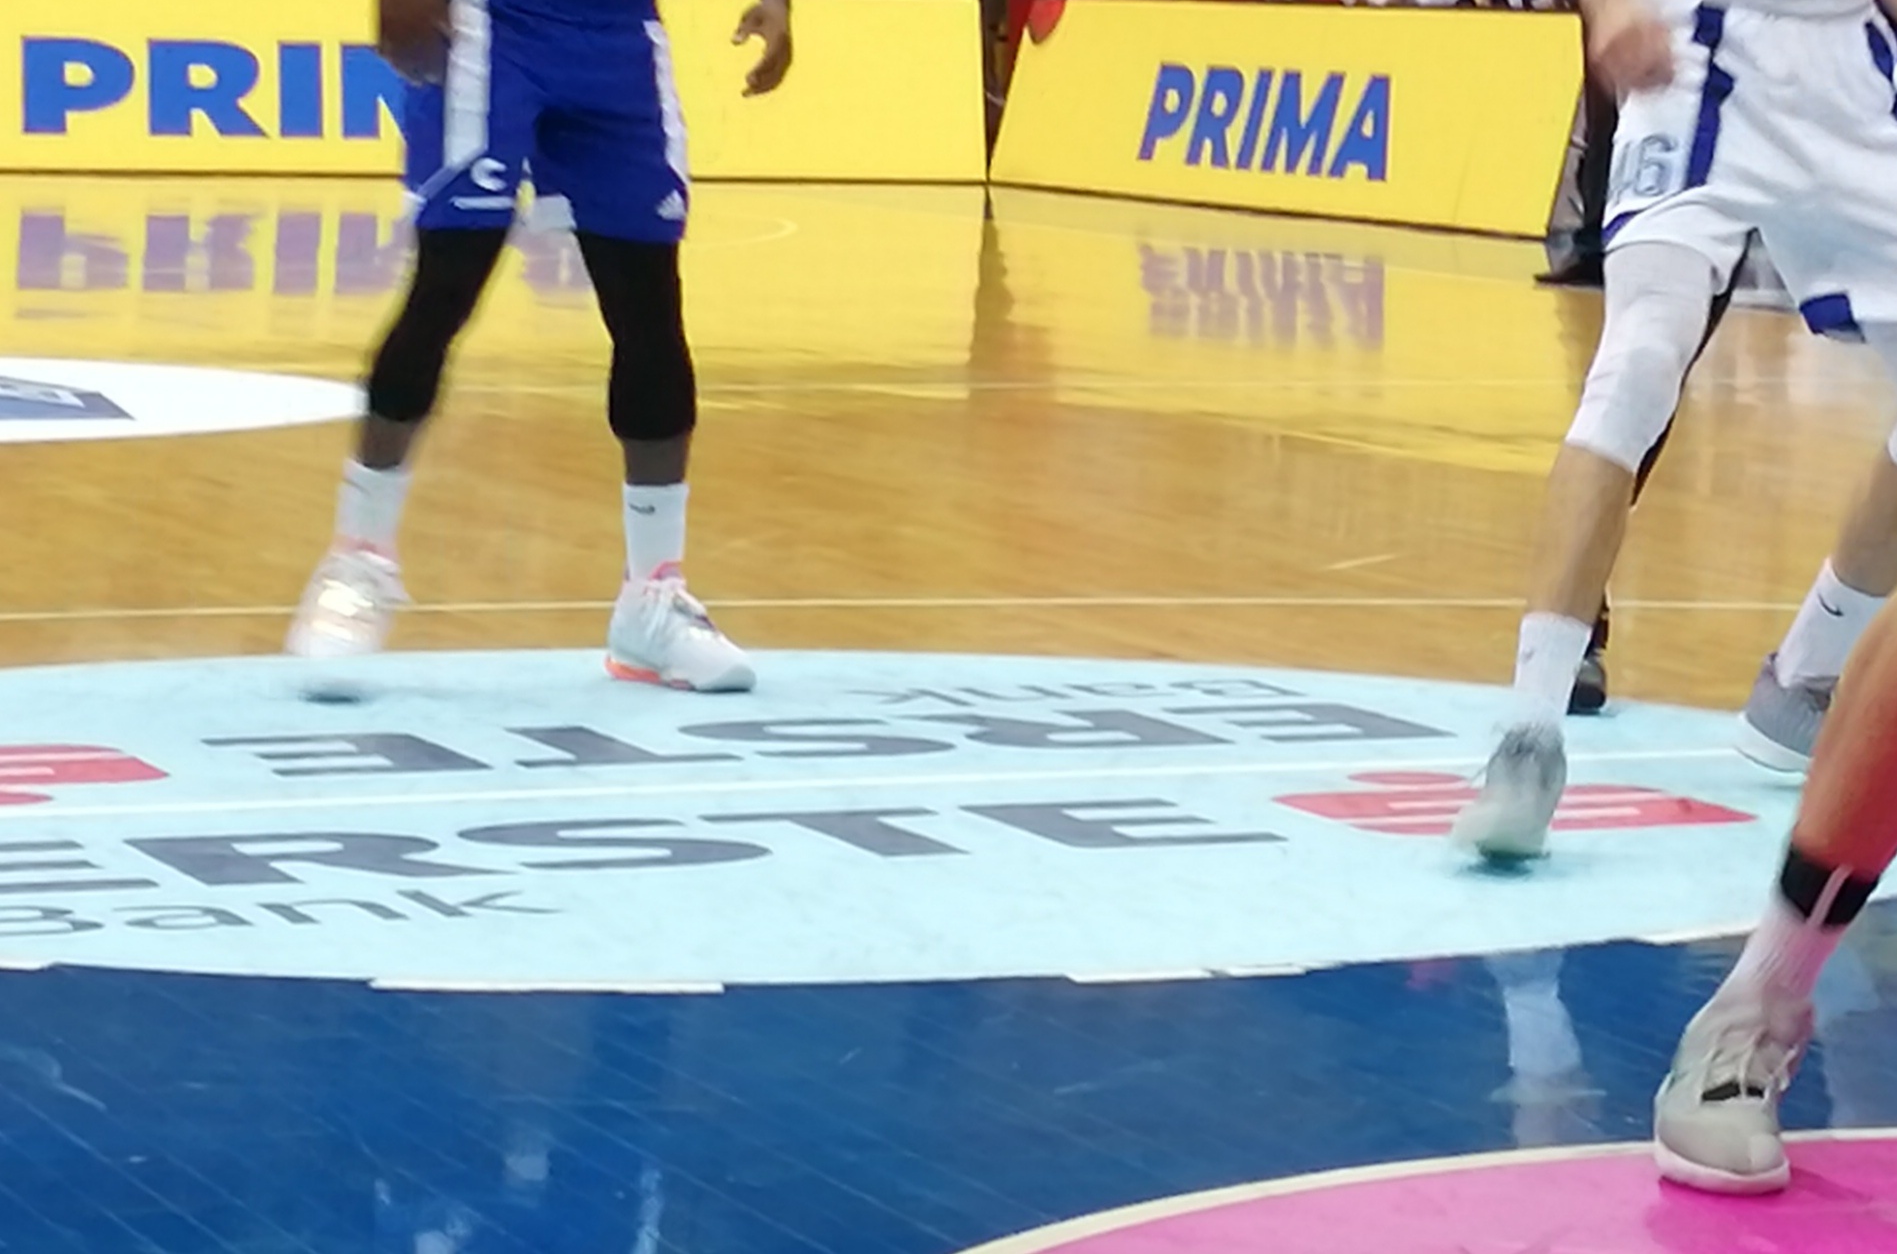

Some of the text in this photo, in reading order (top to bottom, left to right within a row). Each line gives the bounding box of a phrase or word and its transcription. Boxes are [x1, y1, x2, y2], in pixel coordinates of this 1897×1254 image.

[21, 36, 404, 139] PRI
[1137, 62, 1392, 183] PRIMA
[200, 701, 1458, 778] ERSTE
